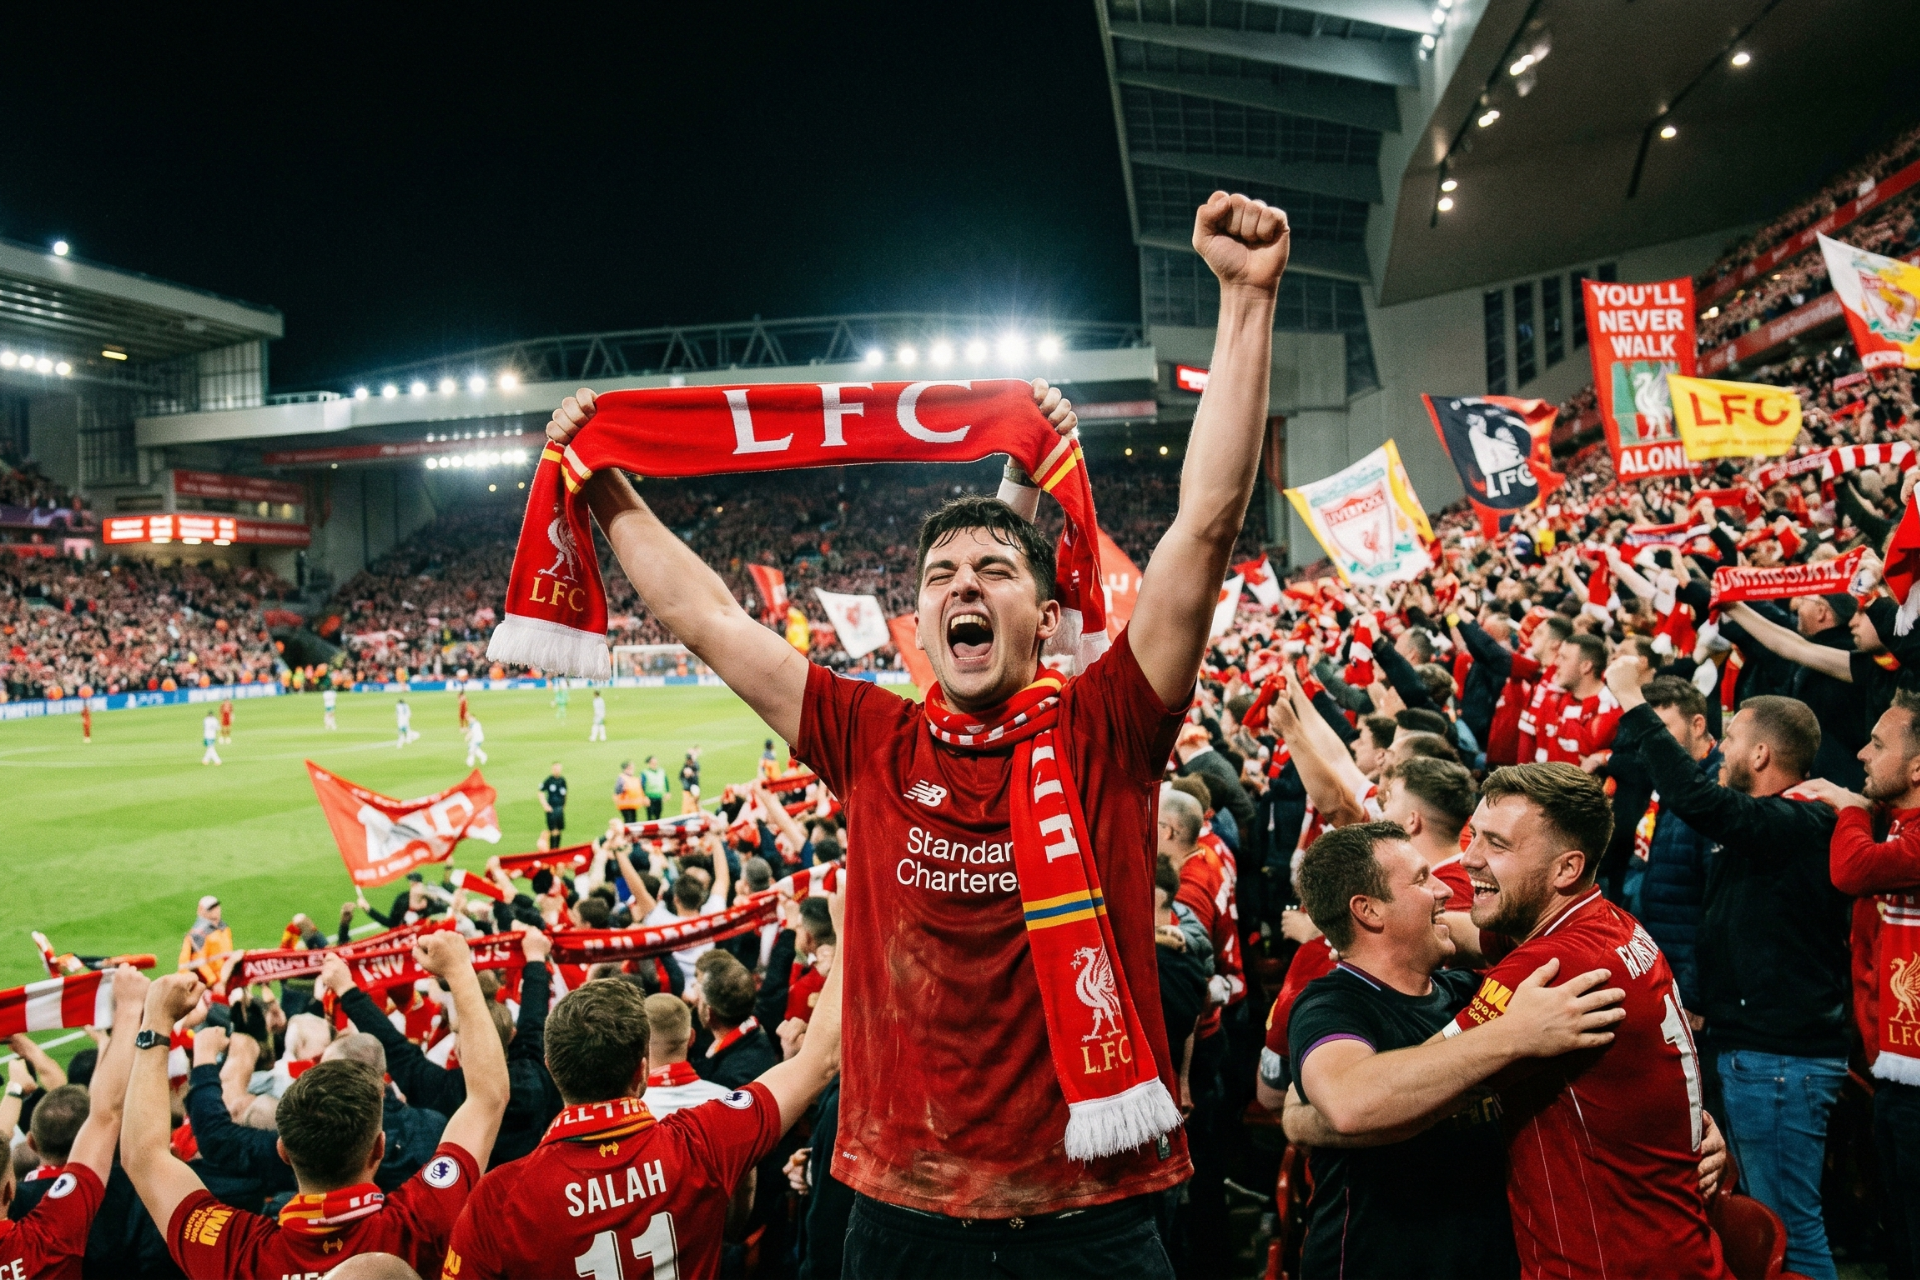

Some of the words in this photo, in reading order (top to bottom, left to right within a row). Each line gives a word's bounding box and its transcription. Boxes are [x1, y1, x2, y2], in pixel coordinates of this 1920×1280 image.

[1590, 284, 1685, 306] YOU'LL
[1597, 309, 1685, 333] NEVER
[1610, 334, 1677, 359] WALK
[722, 381, 972, 455] LFC
[1689, 392, 1790, 426] LFC
[1486, 463, 1537, 499] LFC
[529, 576, 585, 612] LFC
[907, 827, 1014, 864] Standar
[896, 858, 1020, 893] Chartere
[1660, 978, 1703, 1152] 1
[565, 1159, 667, 1217] SALAH
[574, 1211, 680, 1280] 11
